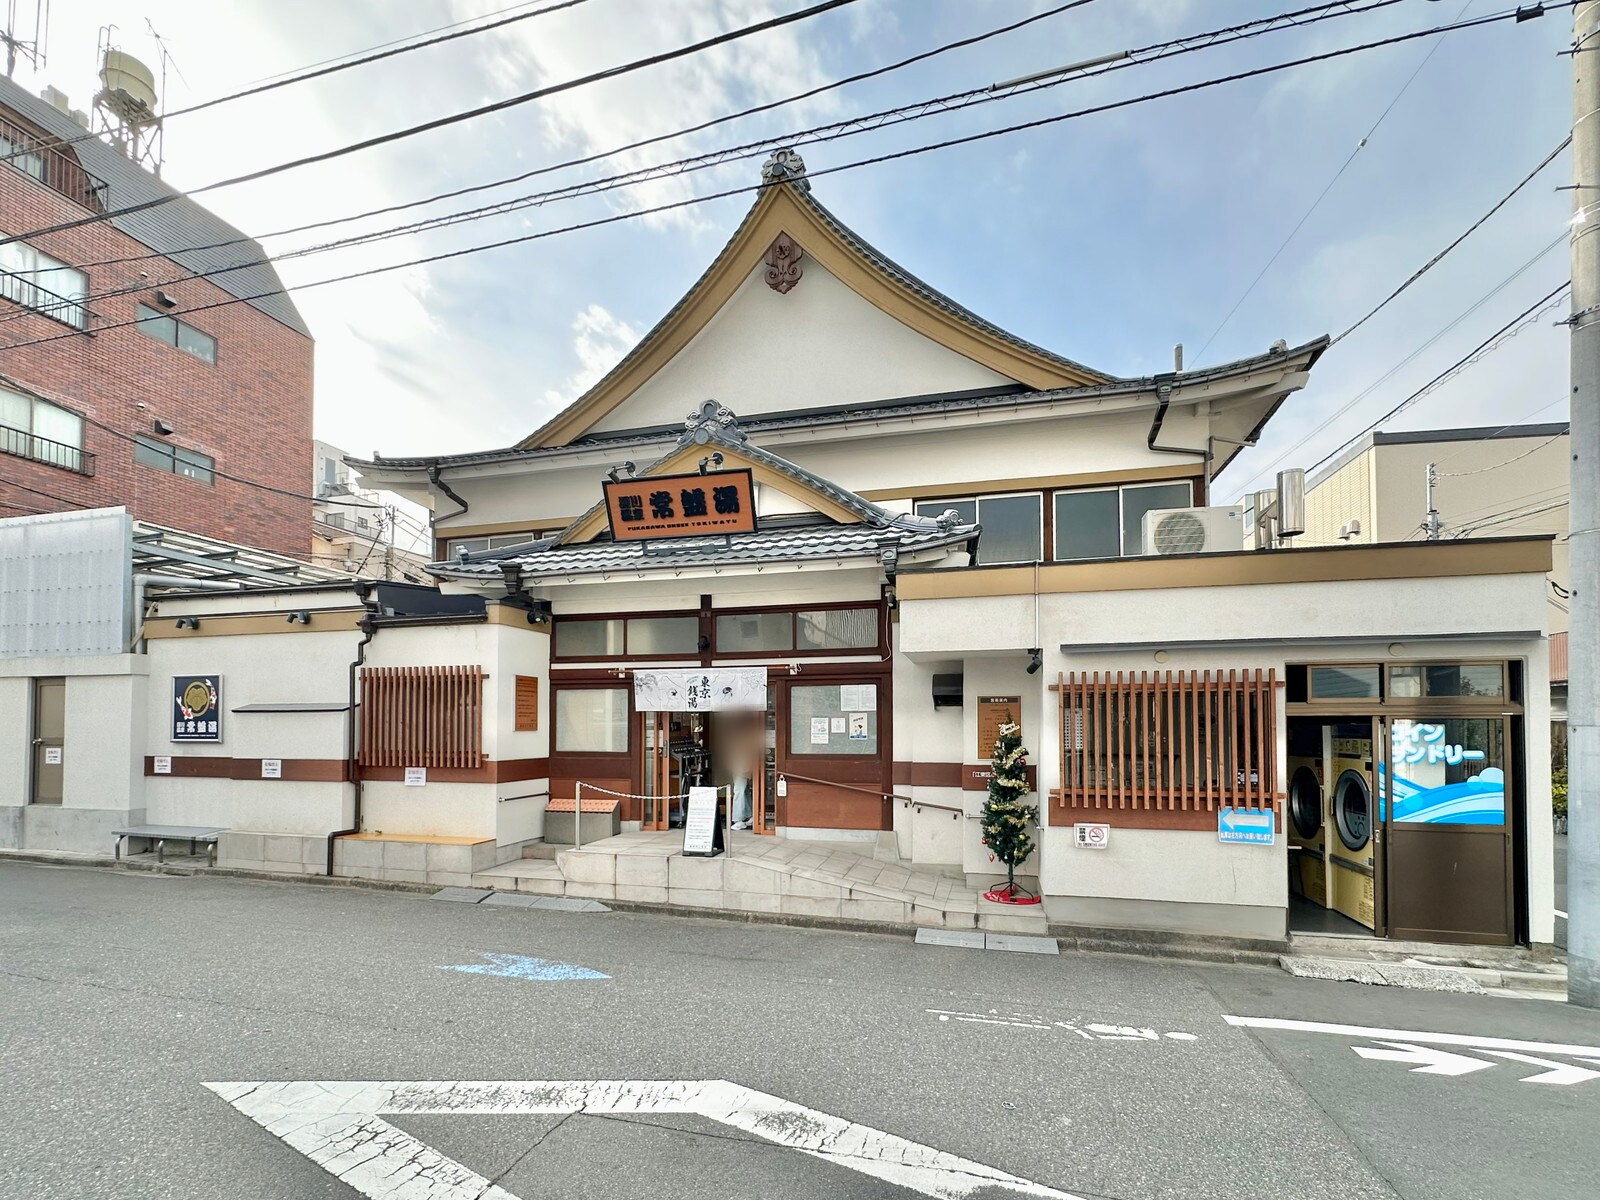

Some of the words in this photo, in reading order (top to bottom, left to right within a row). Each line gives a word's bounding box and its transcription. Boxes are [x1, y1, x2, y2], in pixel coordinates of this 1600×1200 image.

[691, 519, 738, 527] TOKIWAYU
[687, 685, 699, 709] 銭湯
[699, 676, 711, 699] 東京
[1079, 827, 1086, 842] 禁煙
